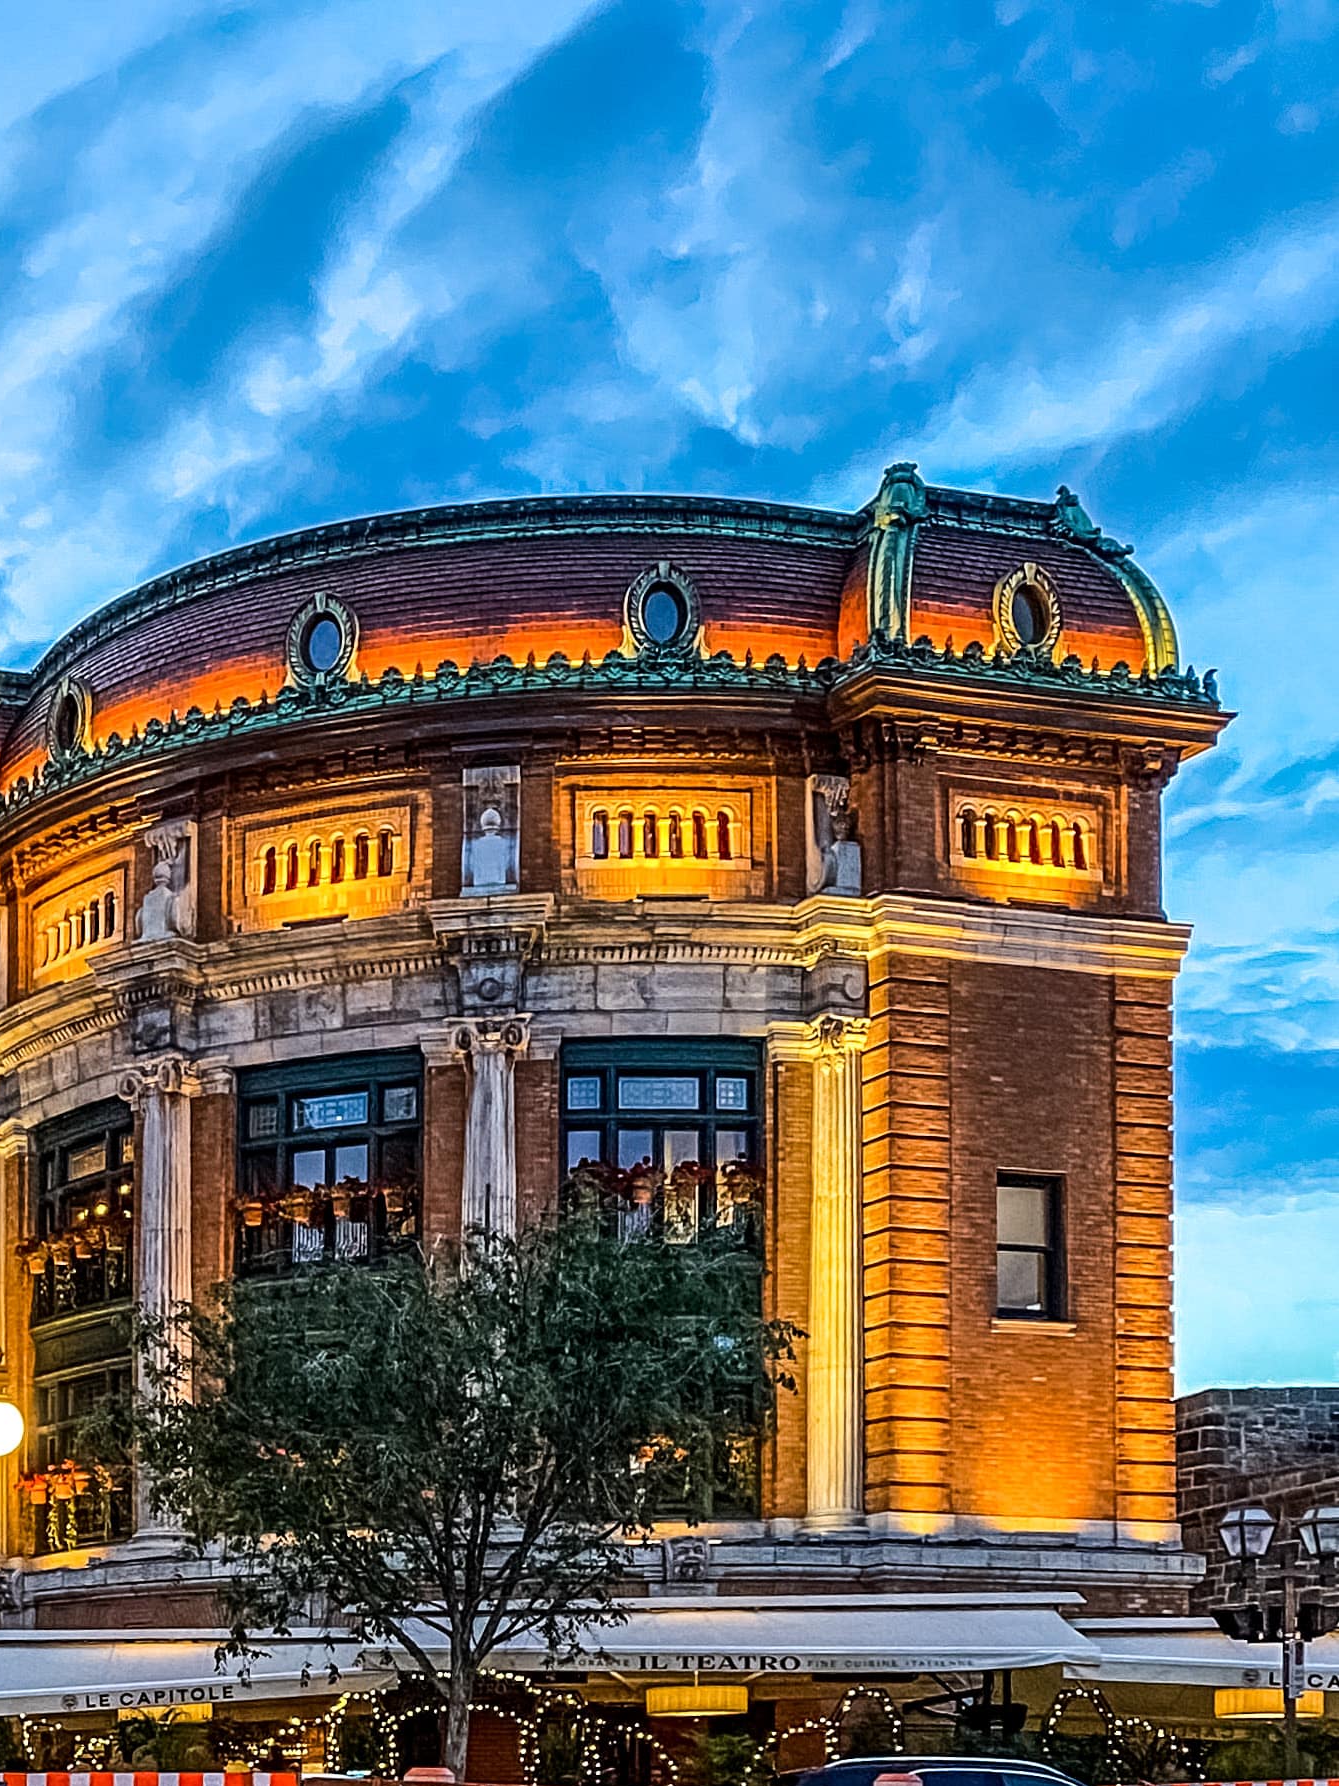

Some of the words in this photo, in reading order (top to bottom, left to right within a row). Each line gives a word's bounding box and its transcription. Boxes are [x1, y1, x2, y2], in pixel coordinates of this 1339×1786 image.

[638, 1655, 668, 1670] IL
[676, 1655, 801, 1671] TEATRO
[85, 1694, 111, 1708] LE
[119, 1685, 234, 1706] CAPITOLE
